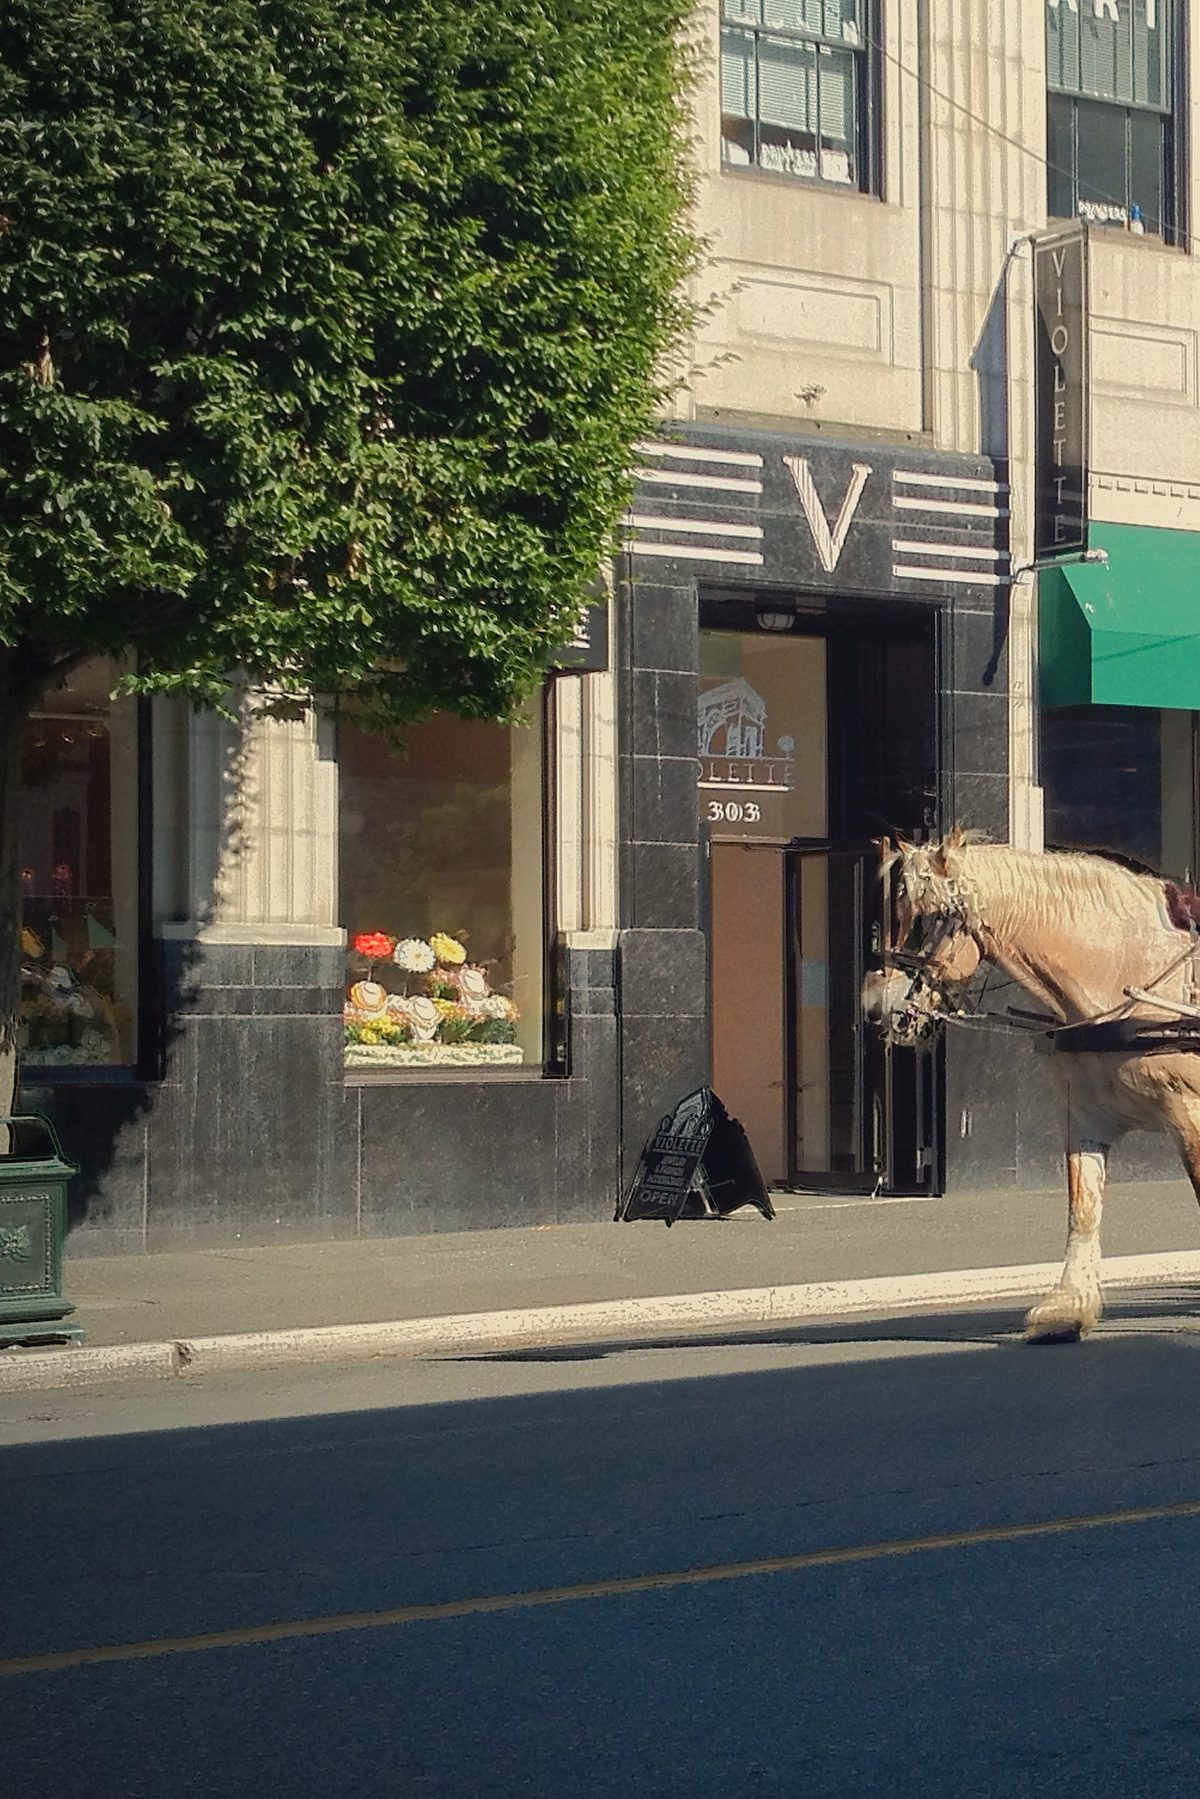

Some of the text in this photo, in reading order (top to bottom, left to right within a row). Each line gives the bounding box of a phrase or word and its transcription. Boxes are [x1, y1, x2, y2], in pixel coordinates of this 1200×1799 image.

[1051, 251, 1069, 544] VIOLETTE
[782, 453, 874, 574] V
[698, 761, 796, 784] LETTE
[706, 800, 761, 822] 303
[655, 1136, 705, 1153] VIOLETTE
[640, 1189, 679, 1206] OPEN
